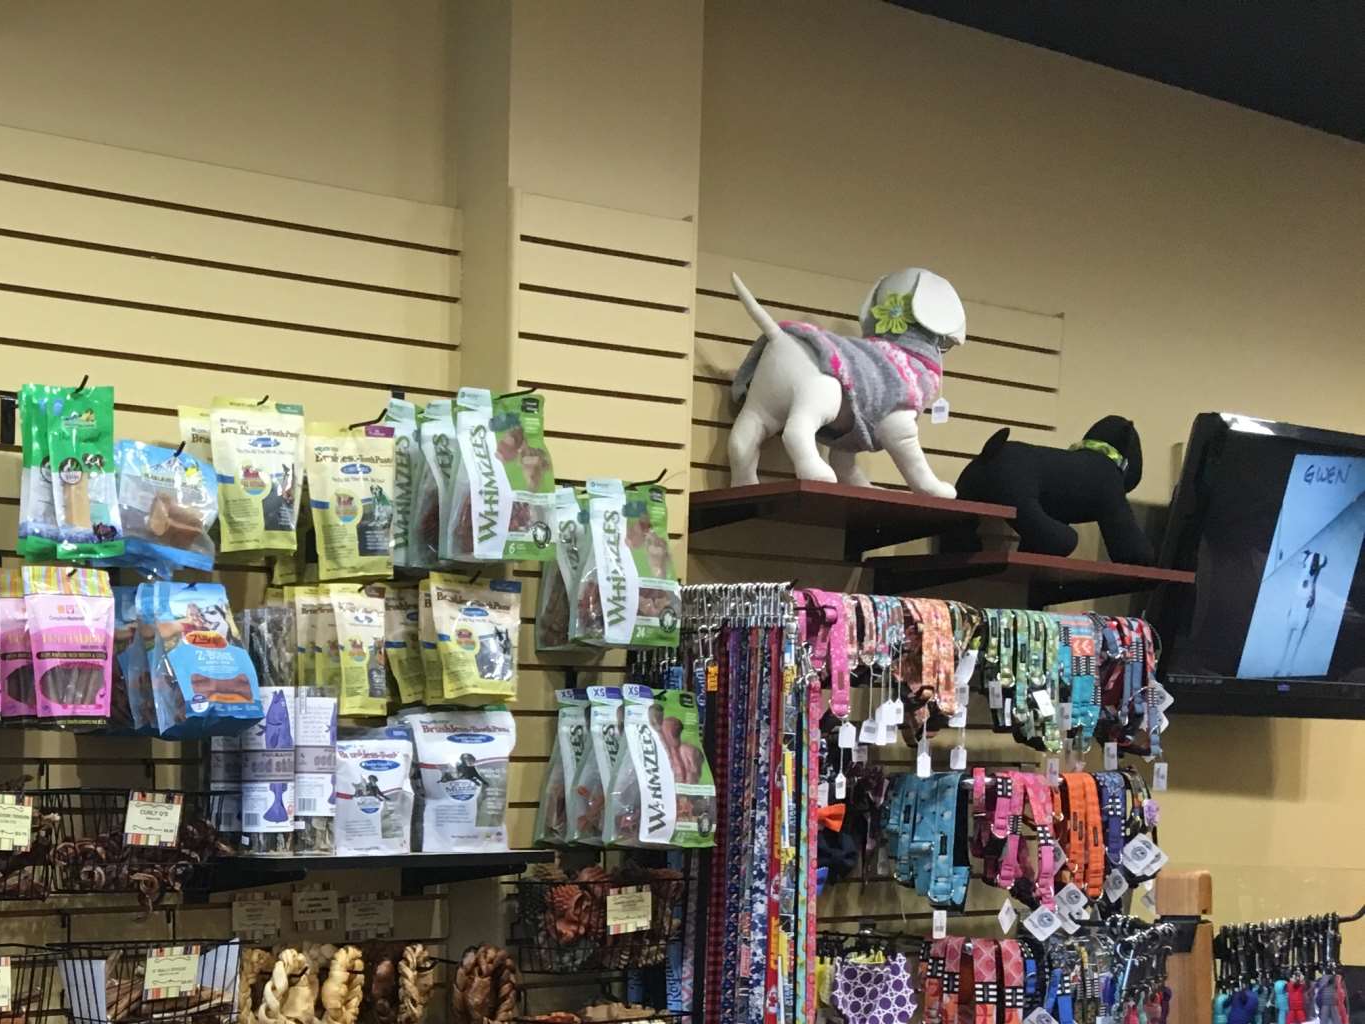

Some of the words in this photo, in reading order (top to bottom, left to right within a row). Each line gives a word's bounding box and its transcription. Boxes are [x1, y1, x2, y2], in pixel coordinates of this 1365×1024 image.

[1304, 464, 1351, 484] GWEN
[562, 690, 574, 700] XS
[593, 687, 606, 697] XS
[627, 685, 640, 697] XS
